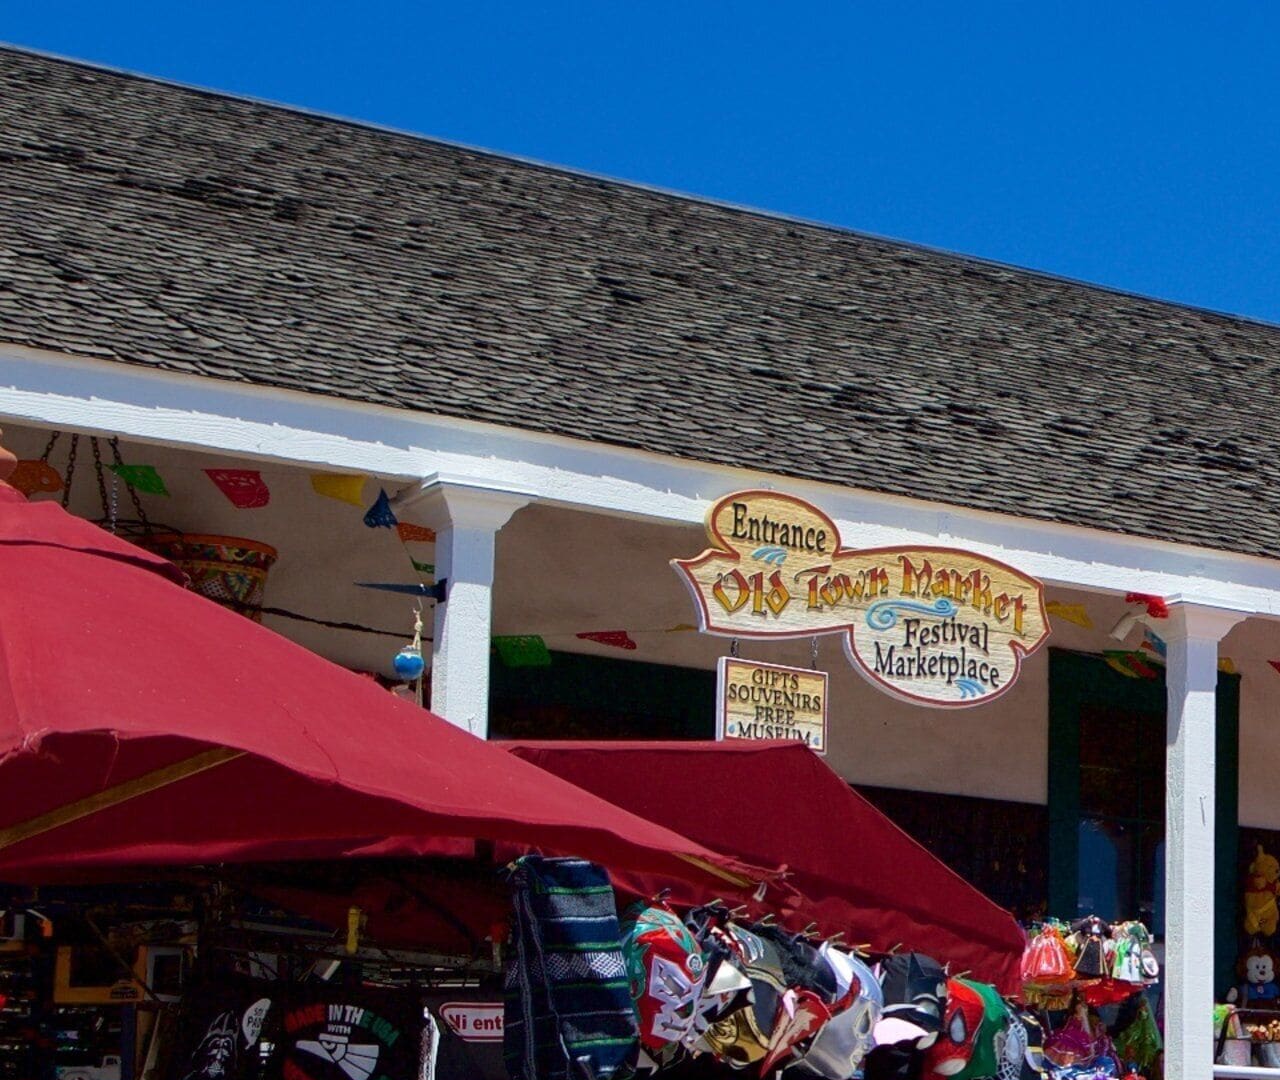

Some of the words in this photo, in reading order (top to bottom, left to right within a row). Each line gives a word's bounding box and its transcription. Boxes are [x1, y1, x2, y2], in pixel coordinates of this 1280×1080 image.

[731, 501, 828, 554] Entrance
[712, 567, 791, 617] Old
[794, 564, 890, 612] Town
[897, 553, 1028, 637] Market
[902, 616, 990, 654] Festival
[873, 641, 1000, 689] Marketplace
[750, 667, 800, 692] GIFTS
[727, 682, 822, 712] SOUVENIRS
[754, 708, 796, 727] FREE
[737, 720, 812, 746] MUSEUM
[327, 1023, 352, 1035] WITH
[328, 1004, 344, 1022] IN
[344, 1005, 376, 1028] THE
[473, 1015, 505, 1030] ent
